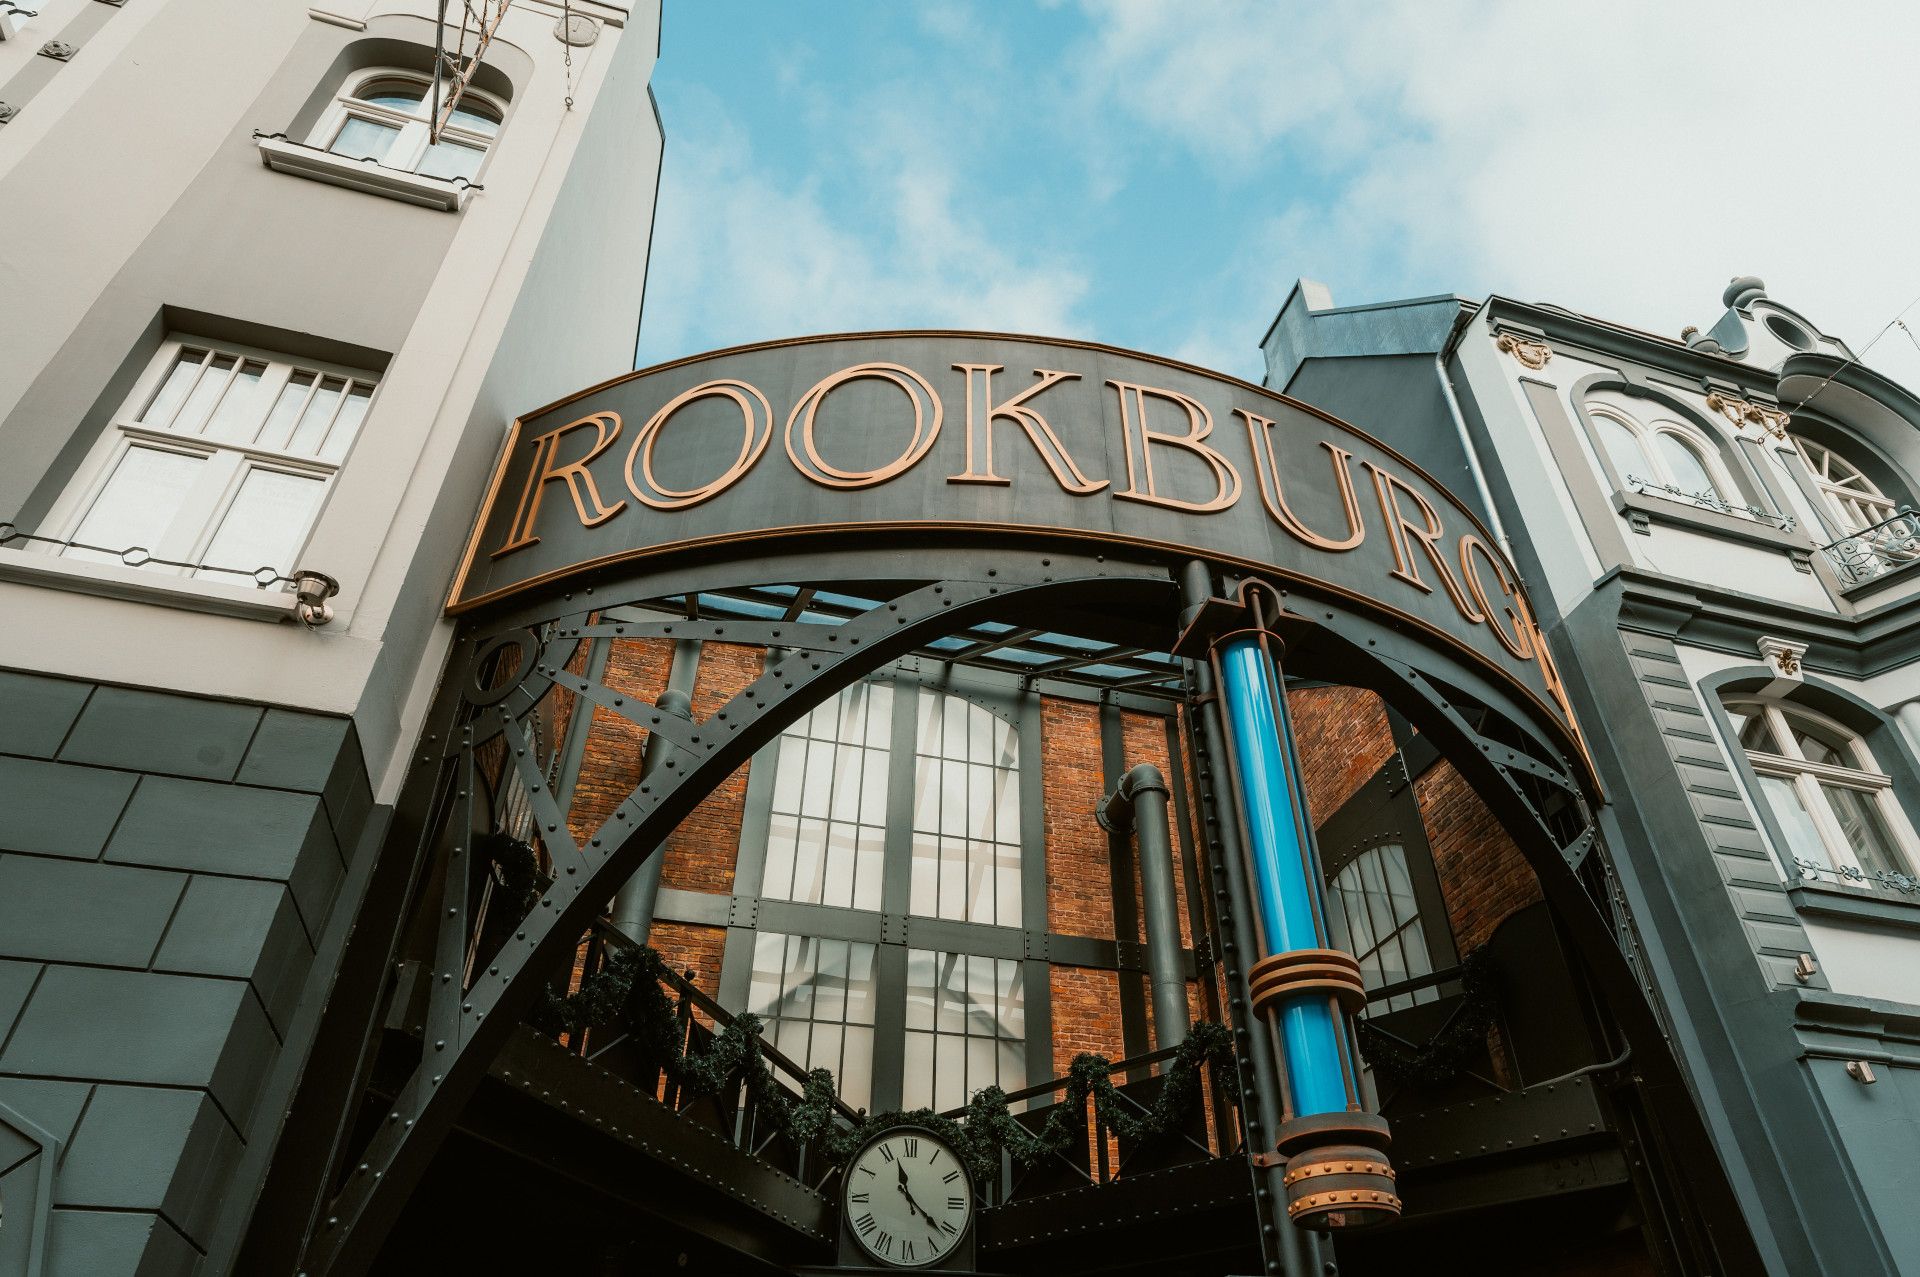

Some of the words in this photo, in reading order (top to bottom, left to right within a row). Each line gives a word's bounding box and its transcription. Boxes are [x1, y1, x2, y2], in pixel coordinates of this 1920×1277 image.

[903, 1138, 918, 1158] XII
[942, 1170, 959, 1184] II
[947, 1197, 964, 1210] III
